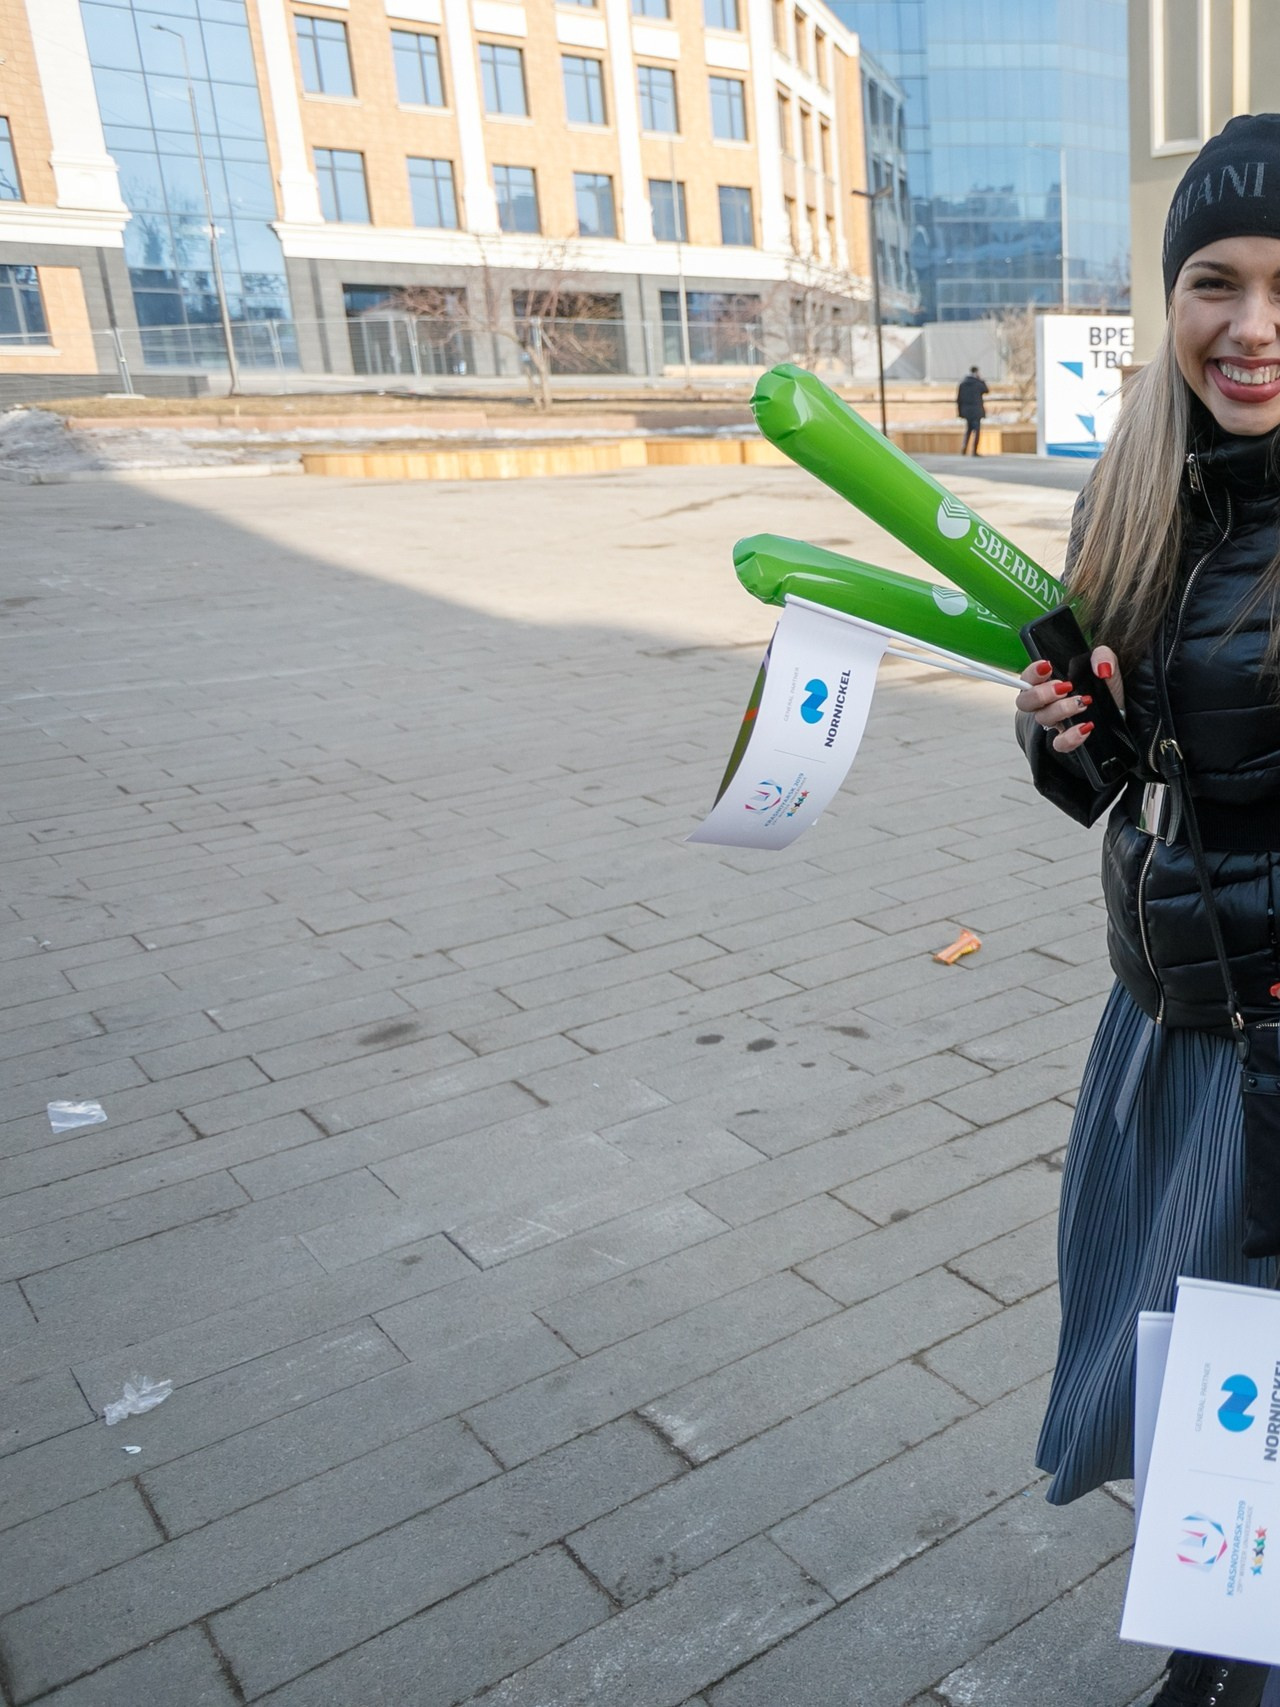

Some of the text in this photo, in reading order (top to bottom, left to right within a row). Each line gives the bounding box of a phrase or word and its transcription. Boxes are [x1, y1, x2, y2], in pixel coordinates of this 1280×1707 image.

[973, 525, 1069, 606] SBERBAN
[824, 670, 851, 748] NORNICKEL
[1226, 1500, 1246, 1596] KRASNOYARSK 2019
